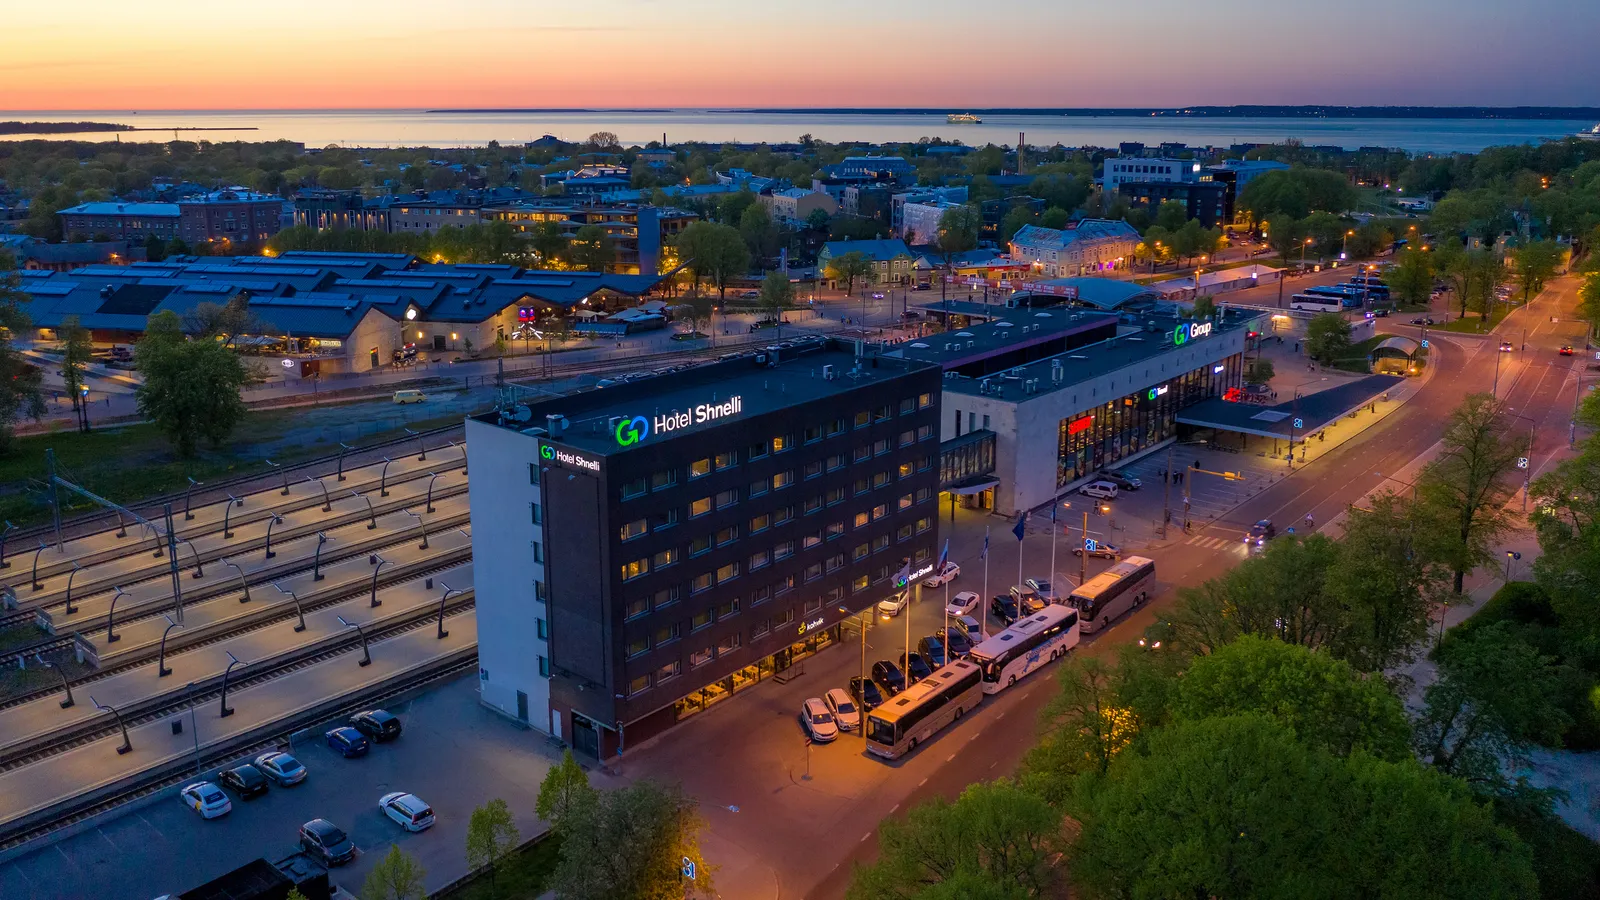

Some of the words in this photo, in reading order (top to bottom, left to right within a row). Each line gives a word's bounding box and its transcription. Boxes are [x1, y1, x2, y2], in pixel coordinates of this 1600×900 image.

[1190, 322, 1212, 338] Group
[616, 416, 649, 446] GO
[654, 408, 692, 434] Hotel
[695, 396, 741, 423] Shnelli
[556, 450, 575, 465] Hotel
[575, 456, 600, 471] Shnelli
